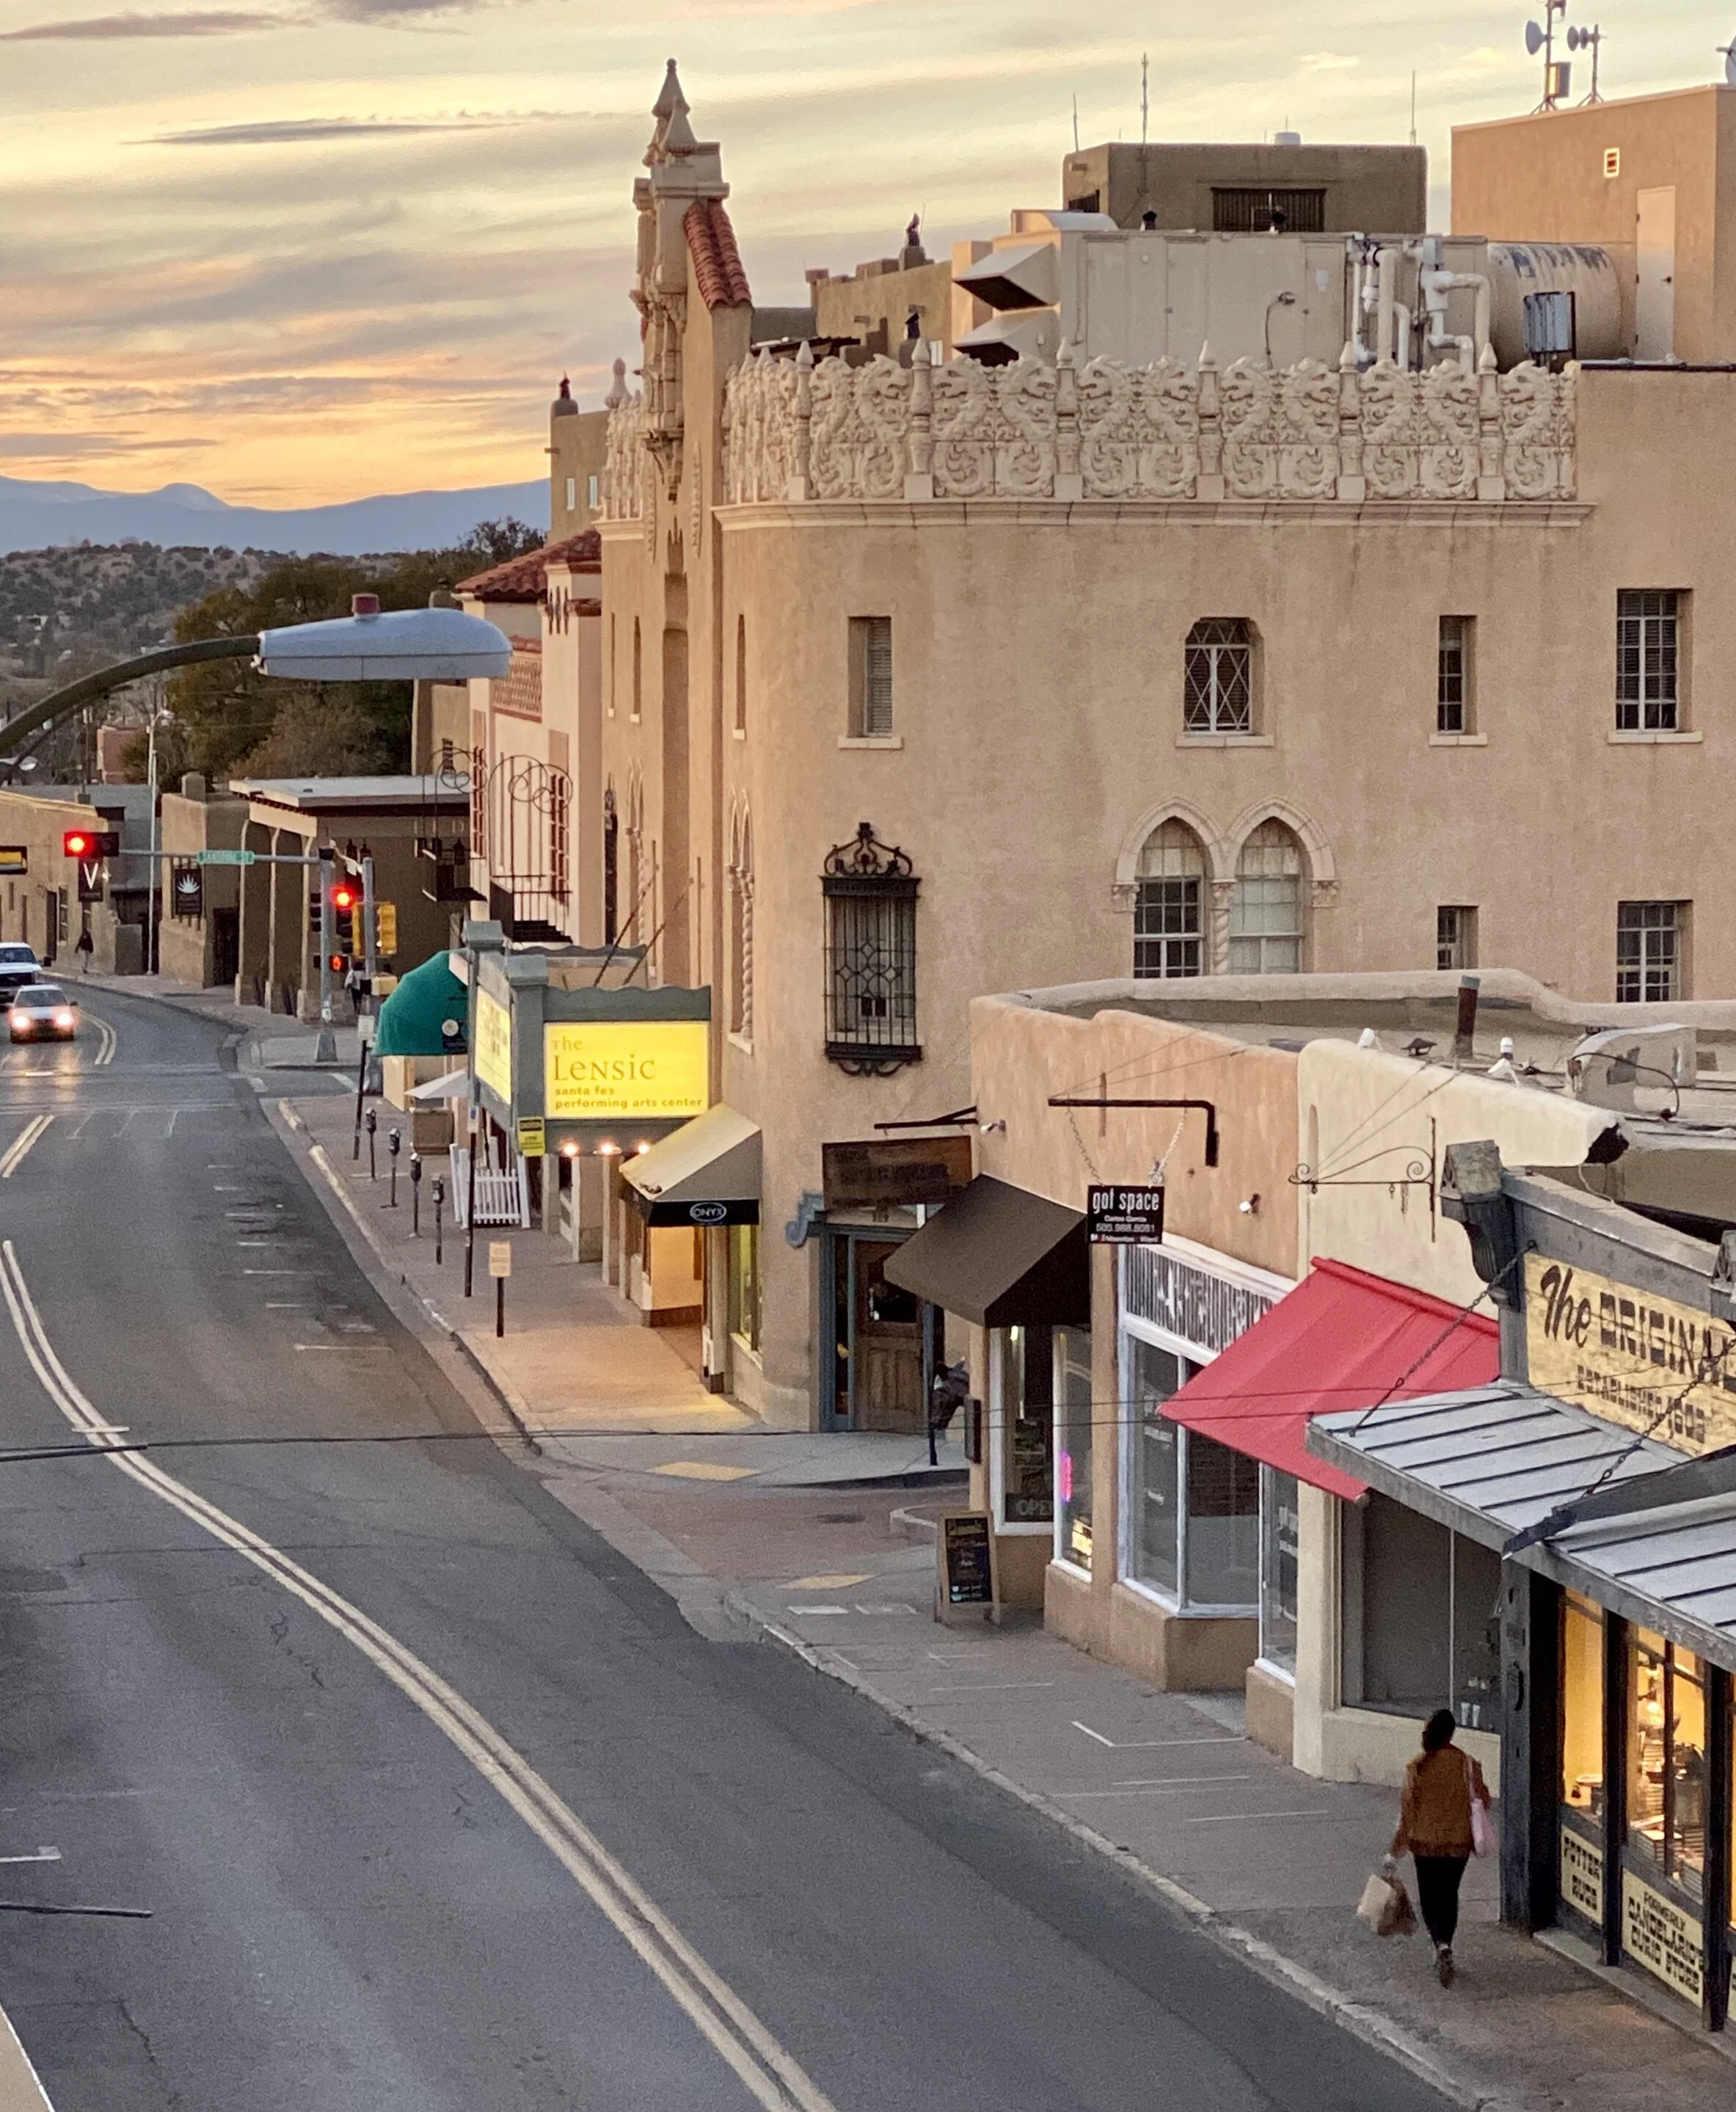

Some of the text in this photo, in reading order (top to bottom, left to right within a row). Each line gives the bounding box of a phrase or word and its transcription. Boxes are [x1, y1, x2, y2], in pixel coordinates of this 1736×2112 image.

[555, 1086, 590, 1096] santa
[555, 1097, 702, 1110] performing arts center
[1093, 1187, 1159, 1215] got space
[693, 1207, 723, 1218] ONYX
[1539, 1264, 1591, 1349] The
[1564, 1835, 1602, 1881] POTTER
